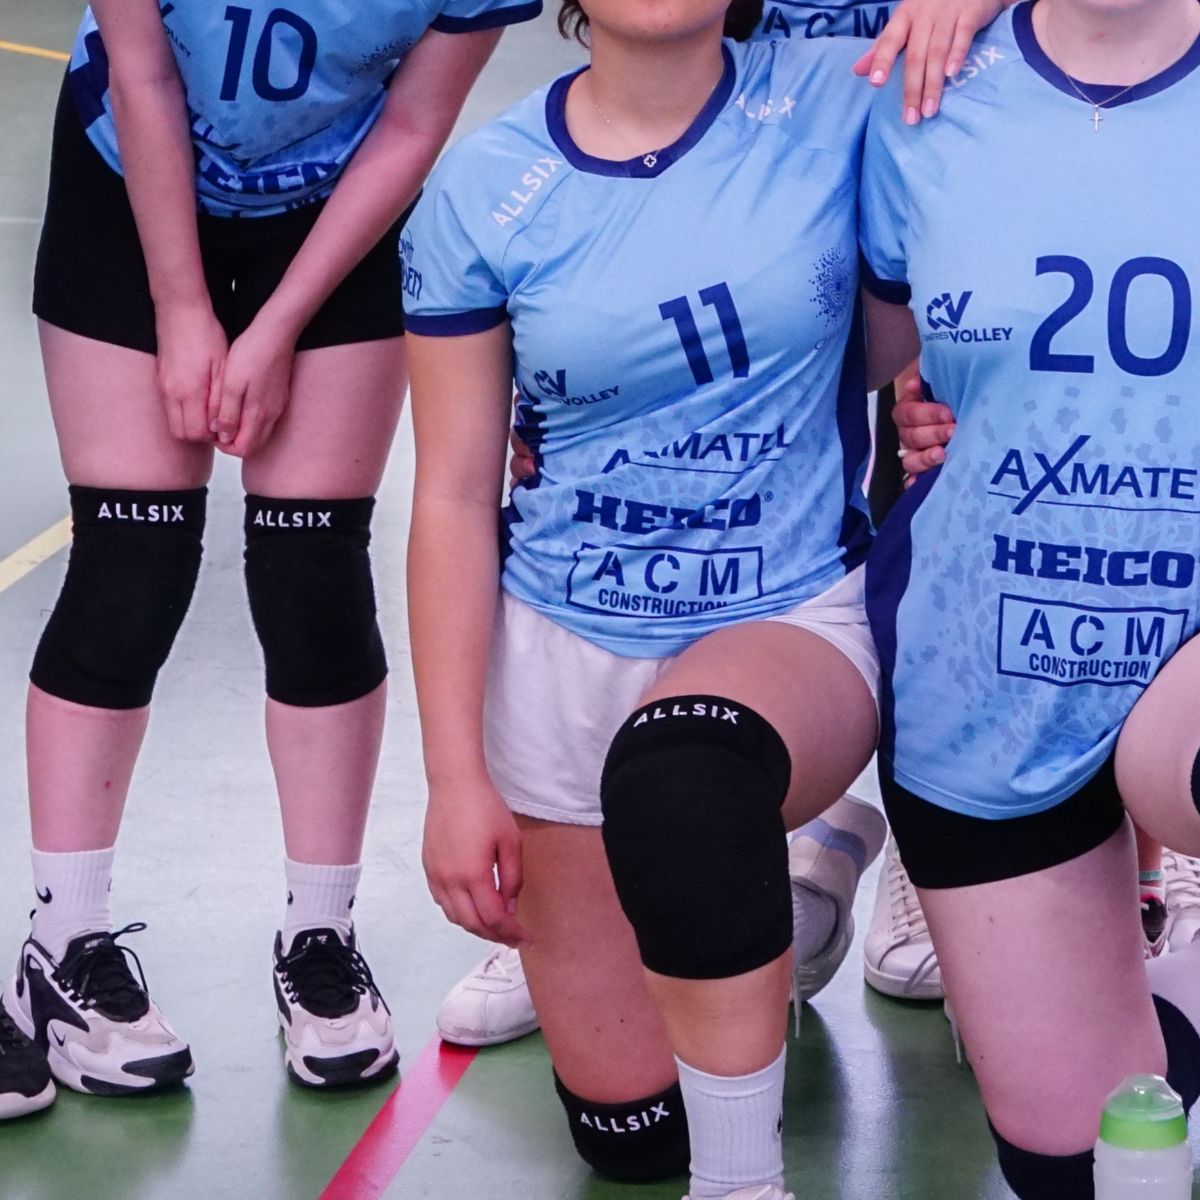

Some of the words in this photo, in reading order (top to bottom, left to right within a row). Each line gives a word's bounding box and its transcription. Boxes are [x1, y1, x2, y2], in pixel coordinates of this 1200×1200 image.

[219, 5, 317, 102] 10
[491, 156, 564, 227] ALLSIX
[1029, 255, 1192, 377] 20
[658, 281, 752, 387] 11
[948, 327, 1013, 344] VOLLEY
[560, 385, 620, 406] VOLLEY
[98, 502, 185, 522] ALLSIX
[253, 510, 332, 528] ALLSIX
[992, 534, 1195, 589] HEICO
[1028, 653, 1152, 681] CONSTRUCTION
[633, 703, 739, 727] ALLSIX
[580, 1102, 670, 1133] ALLSIX
